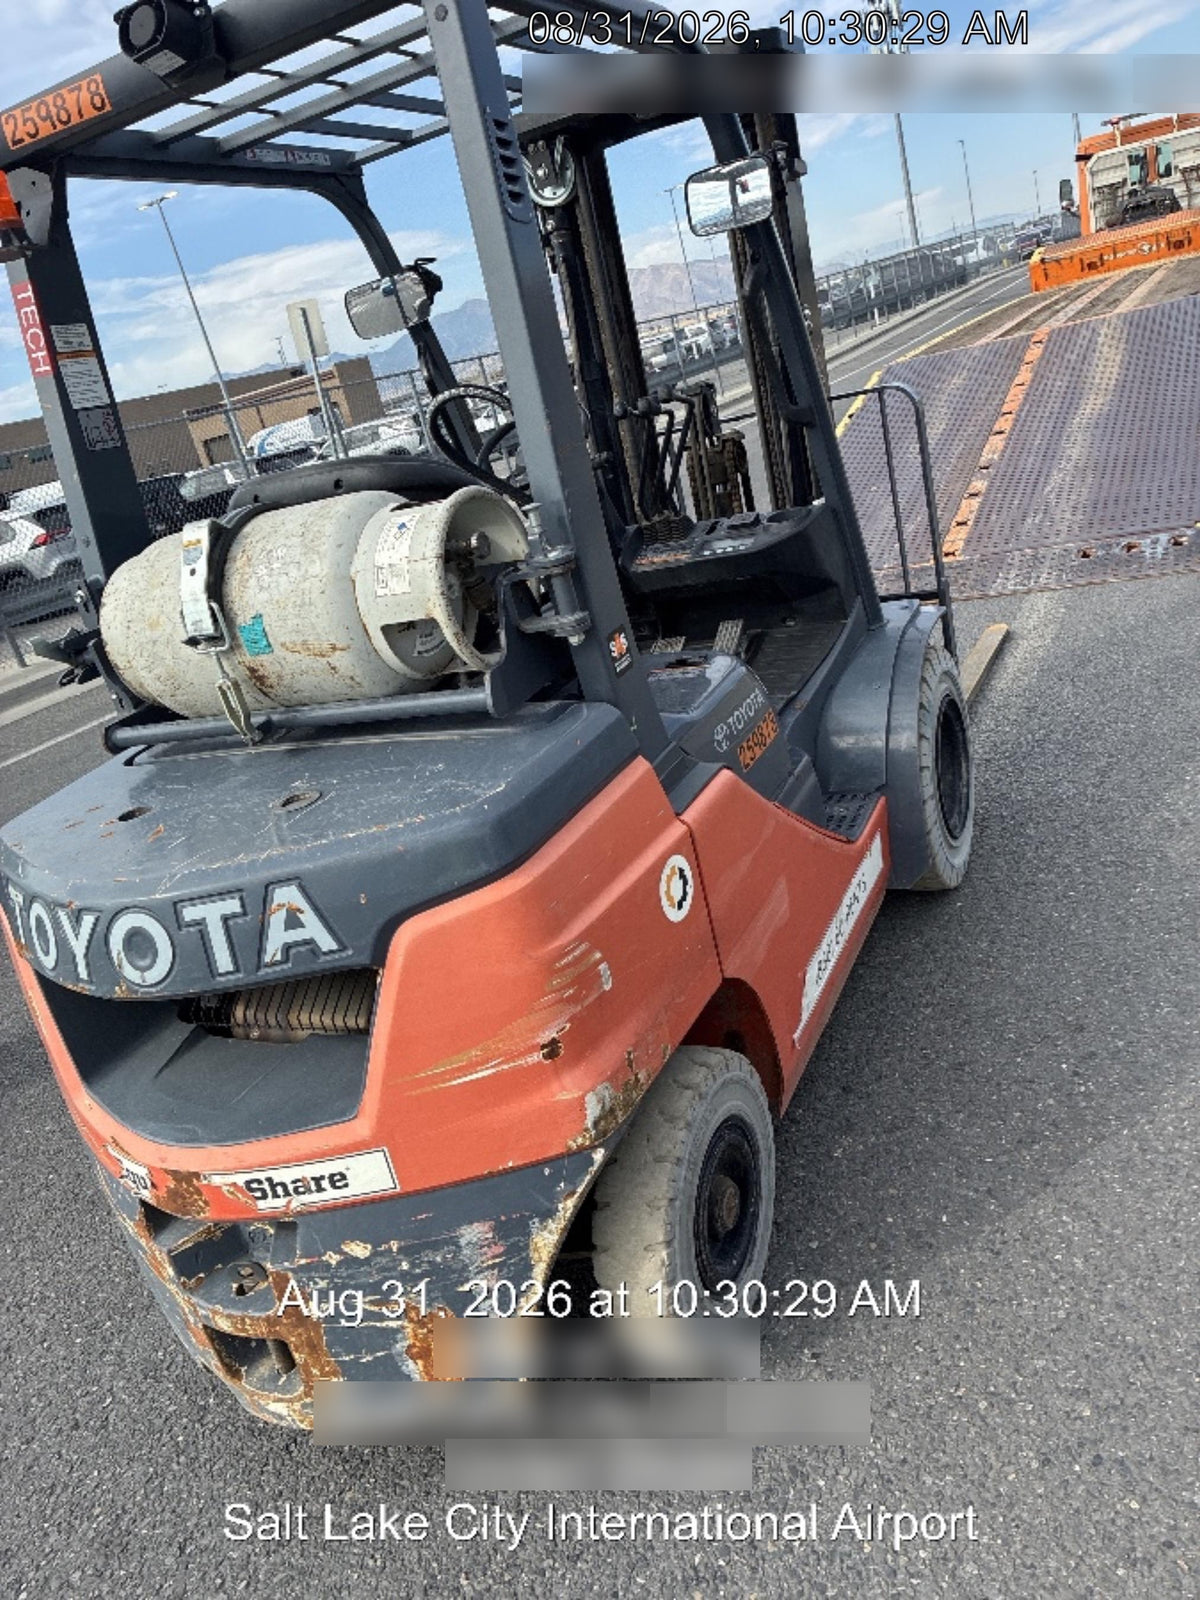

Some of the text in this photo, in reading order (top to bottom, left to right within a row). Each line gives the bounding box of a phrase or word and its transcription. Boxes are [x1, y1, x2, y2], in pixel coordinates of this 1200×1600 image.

[5, 78, 106, 147] 259878
[17, 285, 51, 372] TECH
[727, 688, 765, 735] TOYOTA
[7, 883, 341, 985] TOYOTA
[244, 1170, 350, 1200] Share
